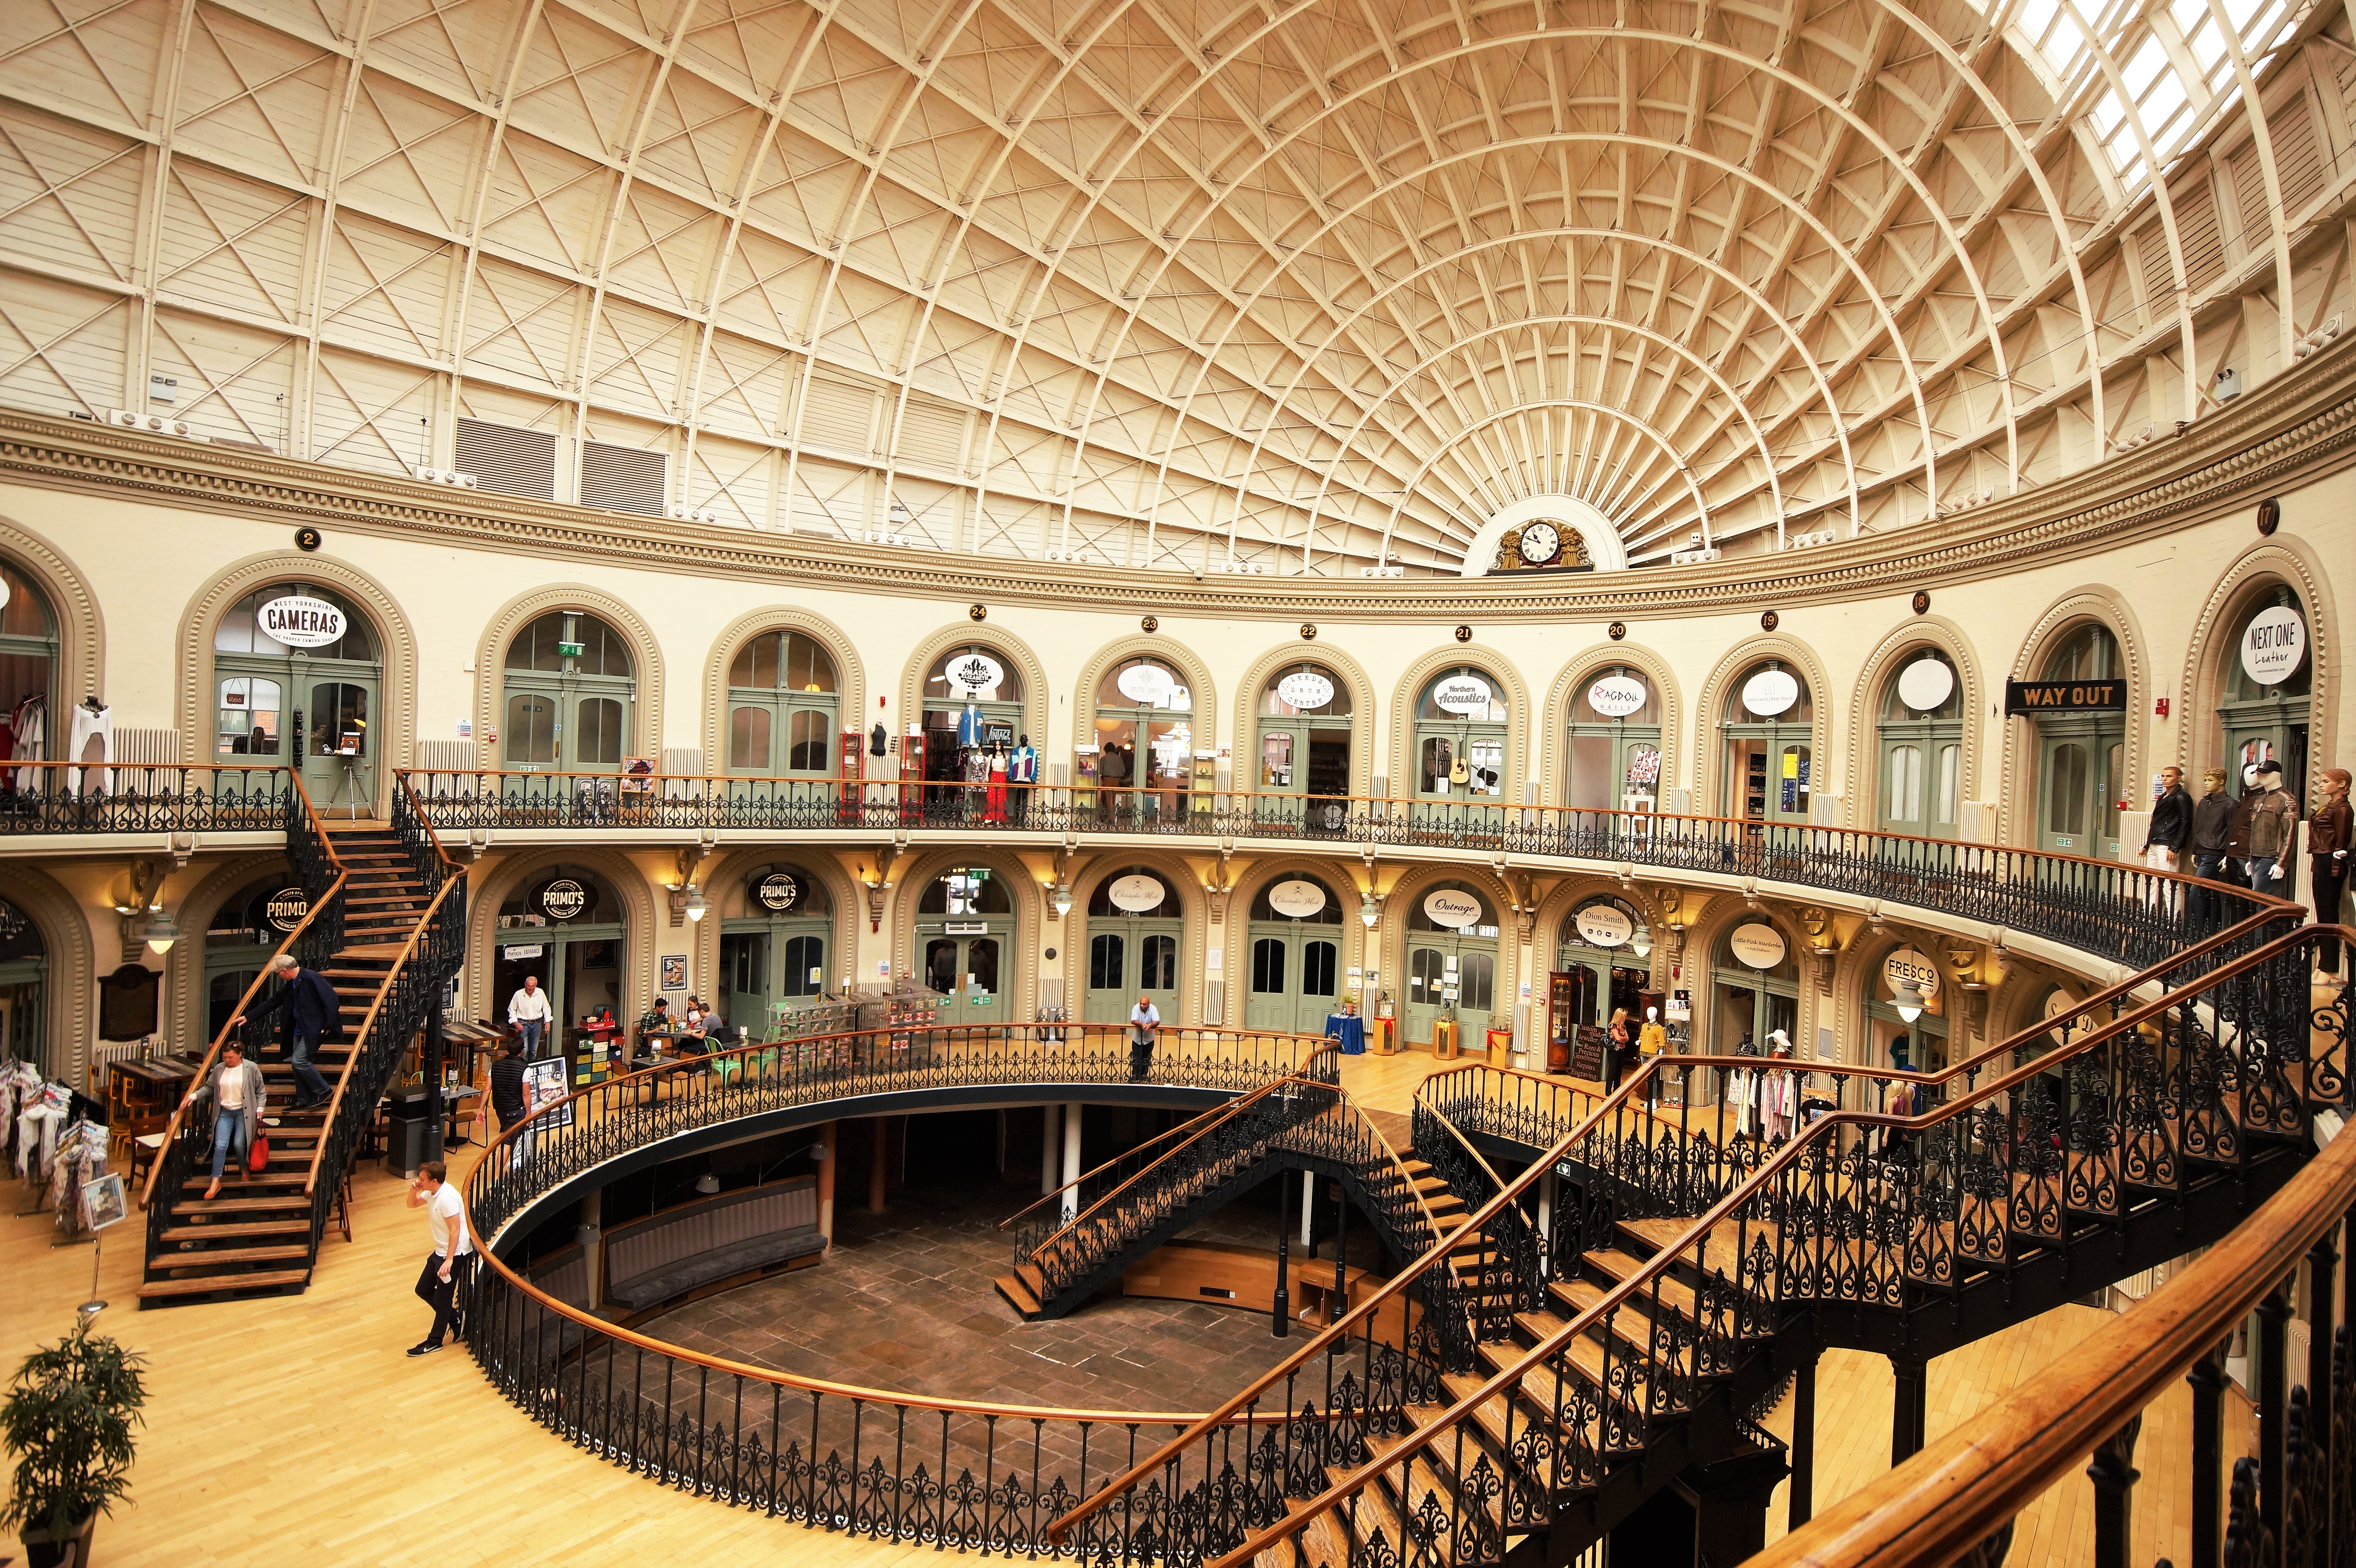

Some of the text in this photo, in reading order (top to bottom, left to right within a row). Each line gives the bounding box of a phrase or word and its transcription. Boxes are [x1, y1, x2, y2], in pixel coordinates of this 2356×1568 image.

[2259, 506, 2271, 526] 17
[304, 533, 314, 545] 2
[295, 601, 333, 611] YORKSHIRE
[1915, 595, 1925, 608] 18
[972, 607, 986, 616] 24
[268, 609, 338, 634] CAMERAS
[1143, 619, 1157, 629] 23
[1763, 615, 1774, 626] 19
[1302, 626, 1315, 635] 22
[1457, 628, 1469, 638] 21
[1610, 626, 1624, 635] 20
[2251, 622, 2295, 651] NEXT ONE
[2255, 651, 2288, 664] Leather
[1291, 676, 1323, 684] LEEDS
[1438, 692, 1486, 705] Acoustics
[1593, 685, 1640, 703] RAGDOLL
[2024, 686, 2113, 705] WAY OUT
[1288, 697, 1323, 706] CENTRE
[987, 726, 1011, 744] VINTAGE
[760, 885, 796, 898] PRIMO'S
[543, 891, 584, 906] PRIMO'S
[267, 902, 309, 918] PRIMO
[551, 907, 567, 916] AMERICAN
[1435, 898, 1475, 916] Outrage
[1585, 911, 1624, 924] Dion Smith
[276, 920, 297, 929] AMERICAN
[1888, 959, 1934, 982] FRESCO
[1578, 1024, 1597, 1033] Custom
[1584, 1043, 1596, 1051] Rare
[1573, 1052, 1601, 1063] GemStones
[1578, 1048, 1599, 1058] Precious
[538, 1064, 552, 1075] THAN
[1576, 1061, 1596, 1071] Repairs
[538, 1073, 552, 1084] DOGS
[1571, 1069, 1596, 1081] Engraving
